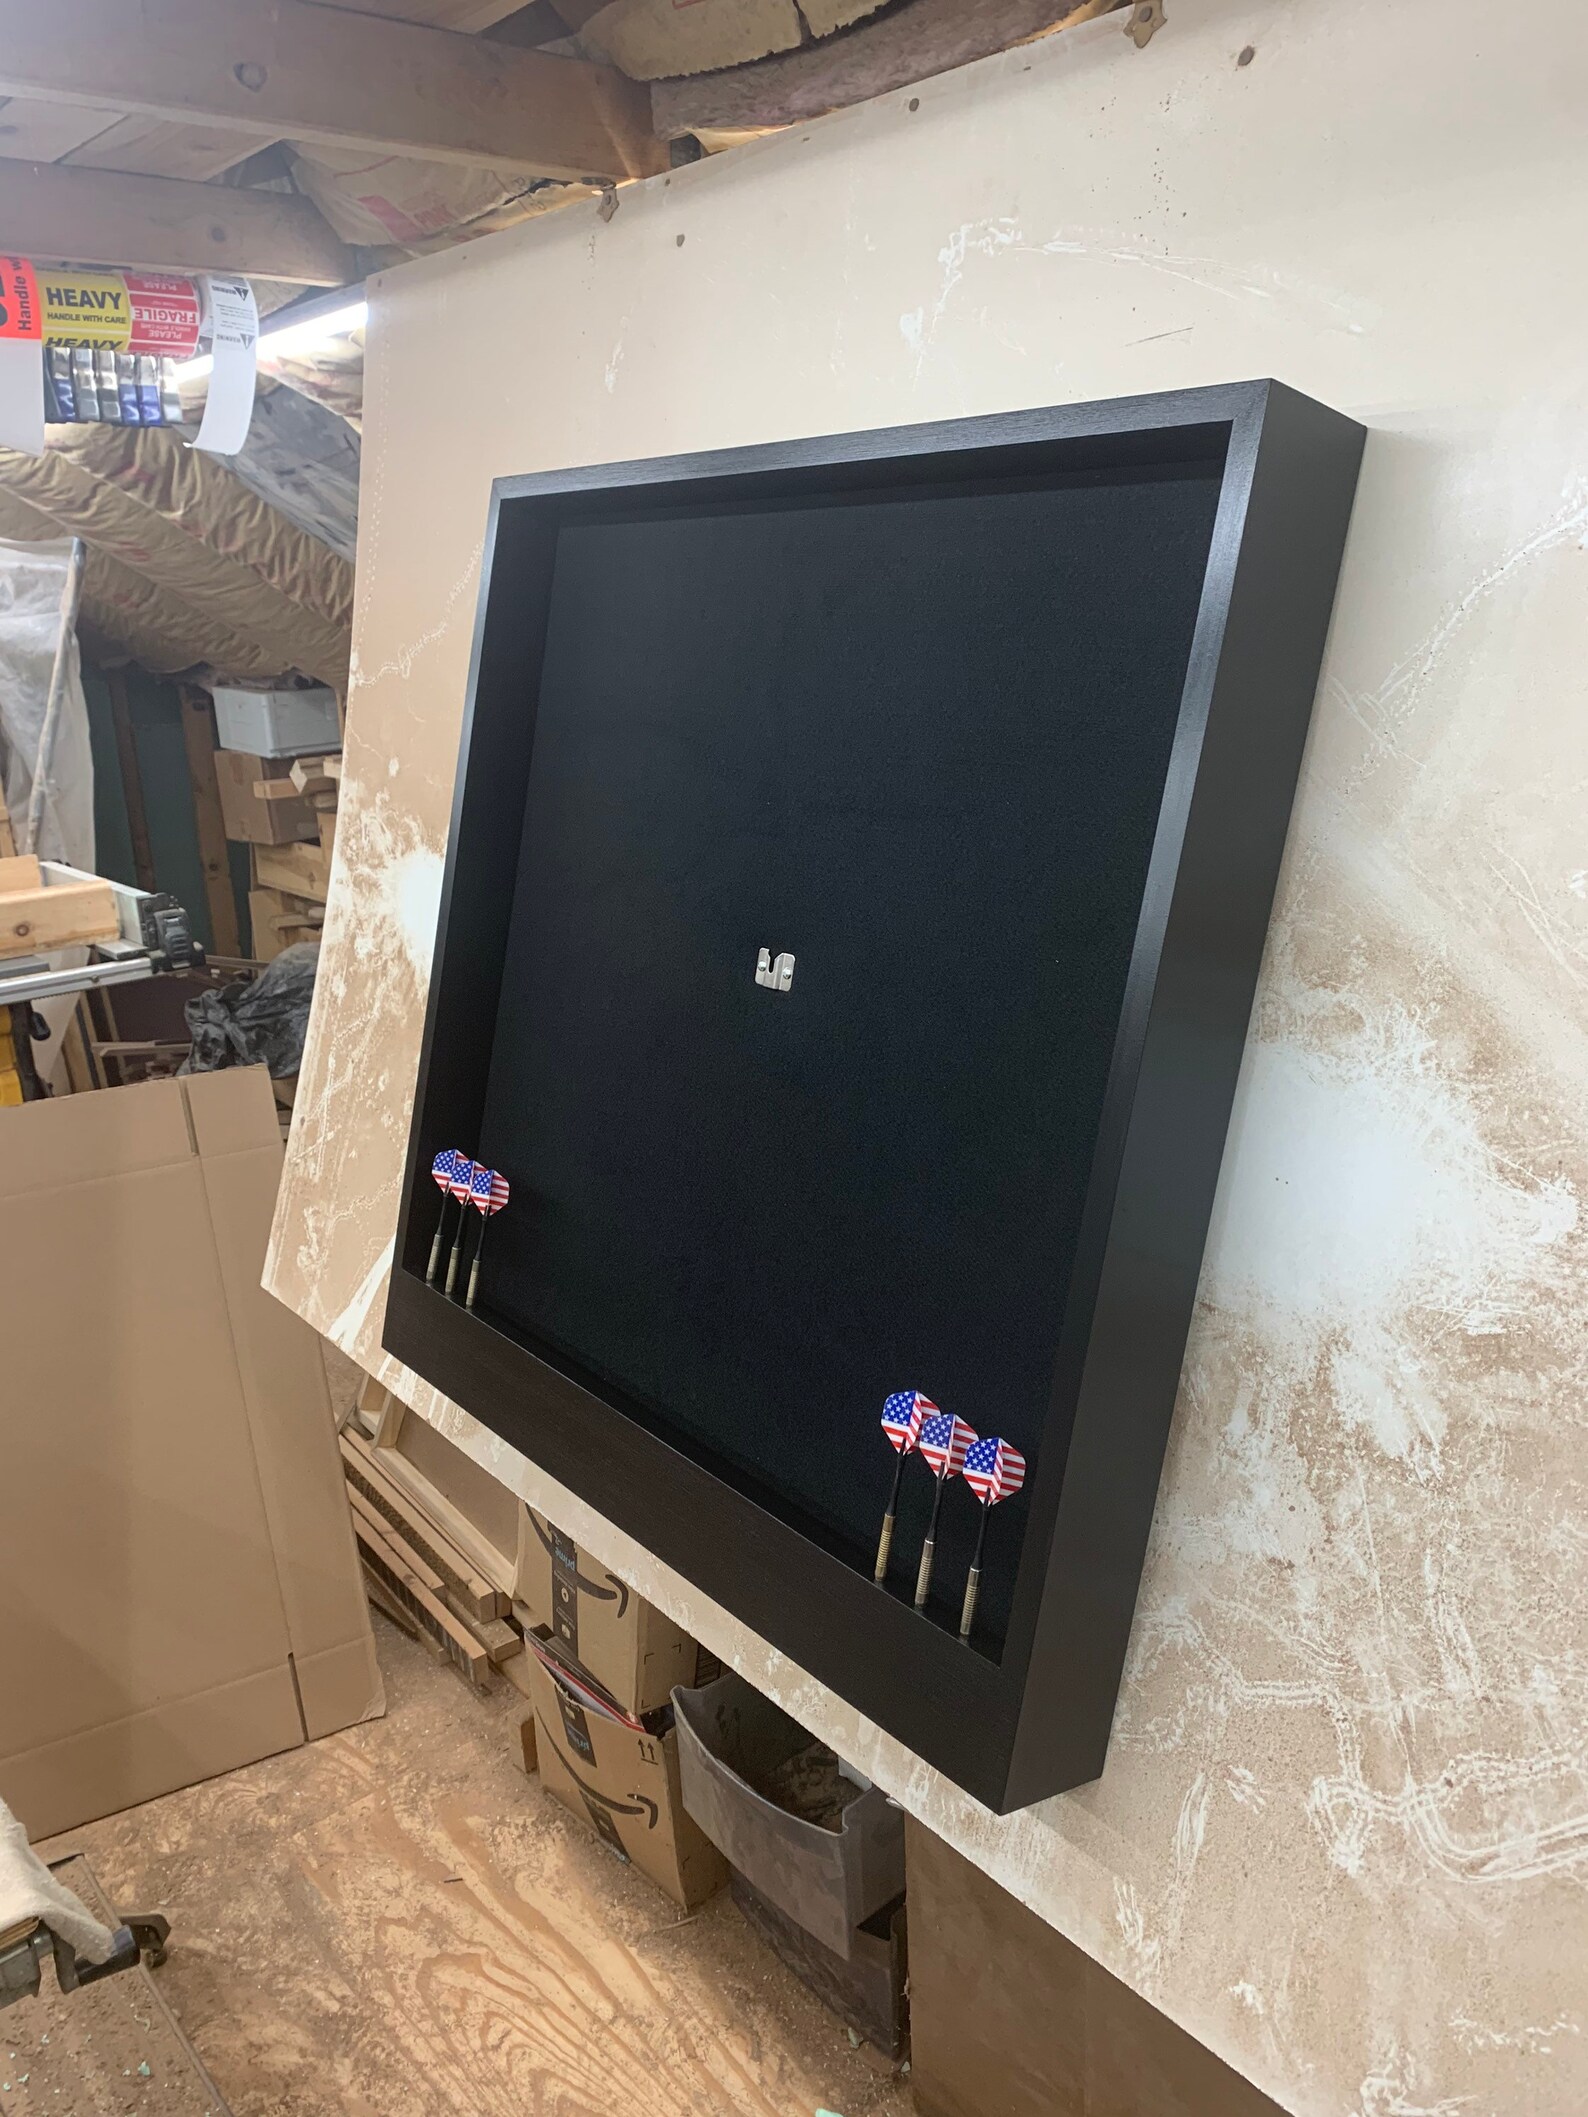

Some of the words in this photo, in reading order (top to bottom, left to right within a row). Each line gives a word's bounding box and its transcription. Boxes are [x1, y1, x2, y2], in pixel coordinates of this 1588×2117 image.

[14, 276, 32, 331] Handle
[46, 287, 122, 310] HEAVY
[47, 312, 80, 322] HANDLE
[82, 314, 103, 323] WITH
[104, 316, 127, 324] CARE
[134, 307, 197, 324] FRAGILE
[148, 330, 182, 339] PLEASE
